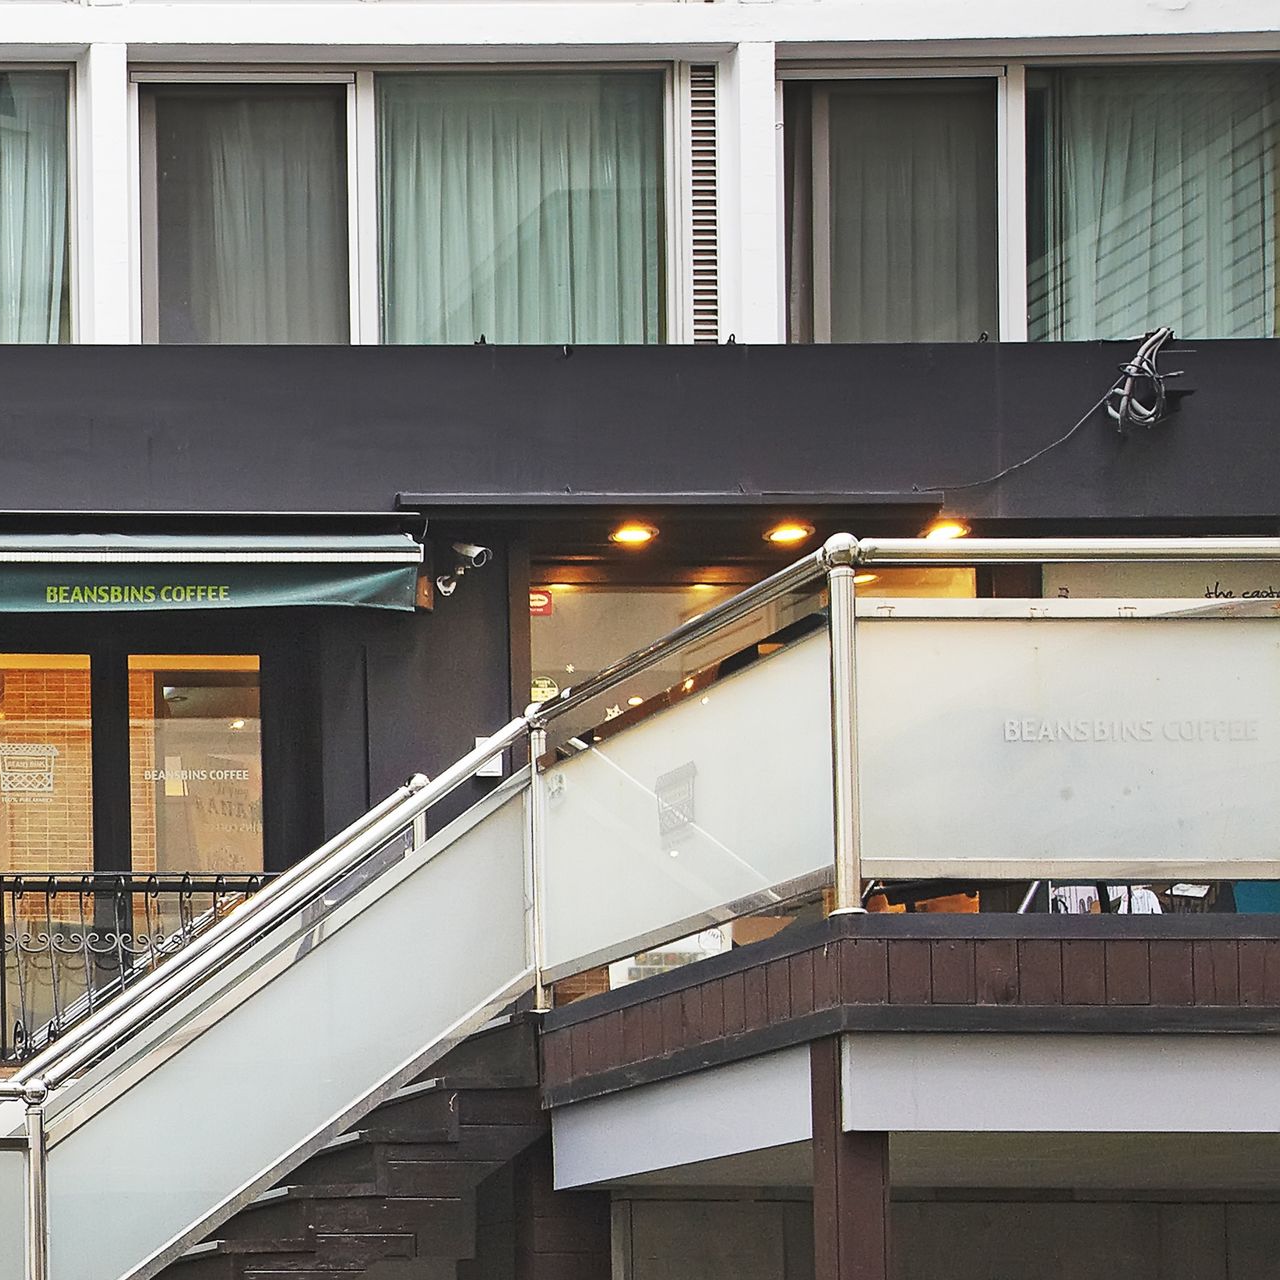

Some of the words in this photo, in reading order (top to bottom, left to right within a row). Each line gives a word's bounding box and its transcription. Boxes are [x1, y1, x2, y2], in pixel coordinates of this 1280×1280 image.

[46, 586, 156, 604] BEANSBINS
[160, 585, 230, 602] COFFEE
[1004, 719, 1154, 742] BEANSBINS
[1161, 719, 1259, 742] COFFEE
[144, 770, 207, 780] BEANSBINS
[209, 770, 249, 780] COFFEE
